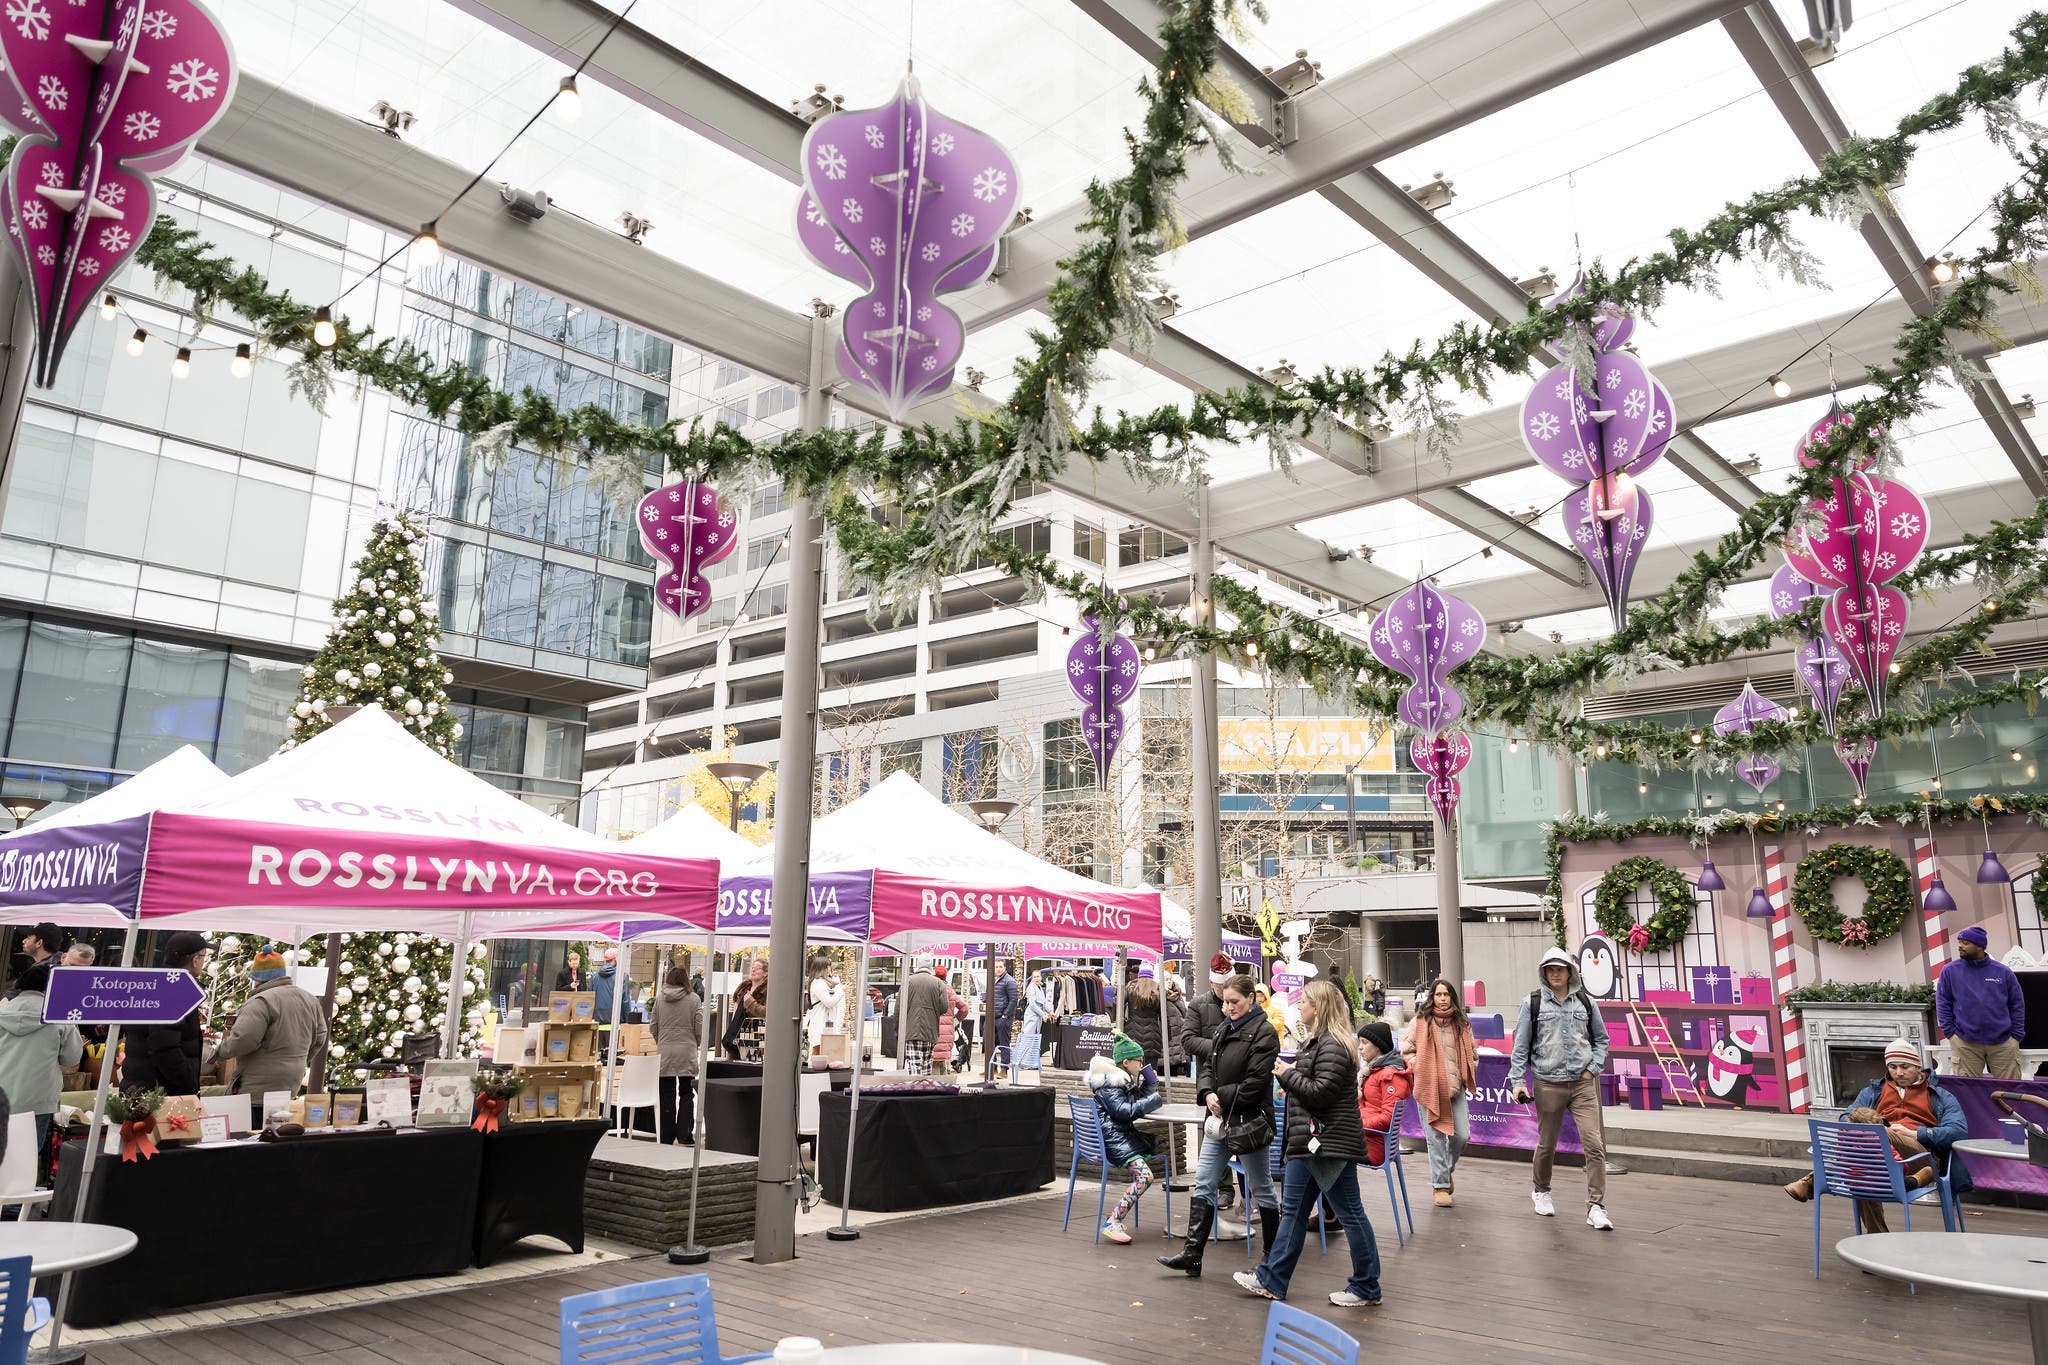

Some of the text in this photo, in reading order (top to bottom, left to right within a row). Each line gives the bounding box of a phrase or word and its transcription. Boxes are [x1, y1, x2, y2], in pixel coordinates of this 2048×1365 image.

[248, 846, 661, 897] ROSSLYNVA.ORG
[921, 888, 1131, 930] ROSSLYNVA.ORG
[91, 976, 157, 993] Kotopaxi
[81, 995, 161, 1009] Chocolates
